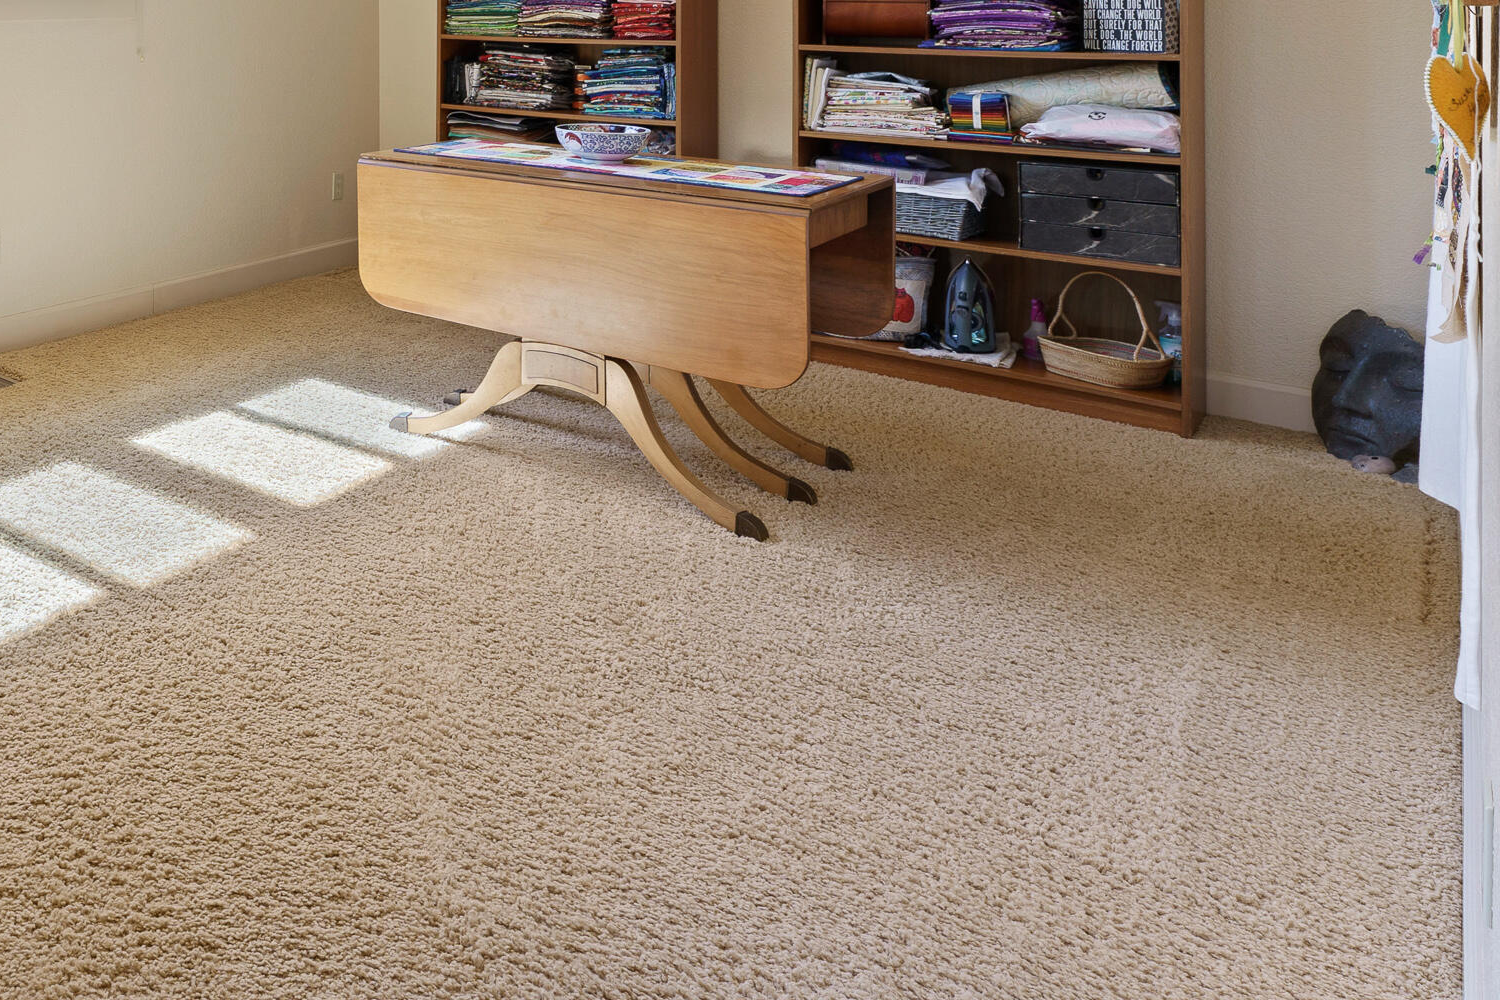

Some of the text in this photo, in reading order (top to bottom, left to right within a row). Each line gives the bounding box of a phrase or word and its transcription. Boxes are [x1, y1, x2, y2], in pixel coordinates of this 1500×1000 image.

[1084, 0, 1162, 9] SAVING ONE DOG WILL
[1084, 10, 1095, 19] NOT
[1097, 10, 1122, 19] CHANGE
[1124, 10, 1135, 19] THE
[1084, 20, 1162, 30] BUT SURELY FOR THAT
[1084, 30, 1097, 39] ONE
[1120, 30, 1133, 40] THE
[1136, 31, 1162, 40] WORLD
[1084, 40, 1162, 51] WILL CHANGE FOREVER
